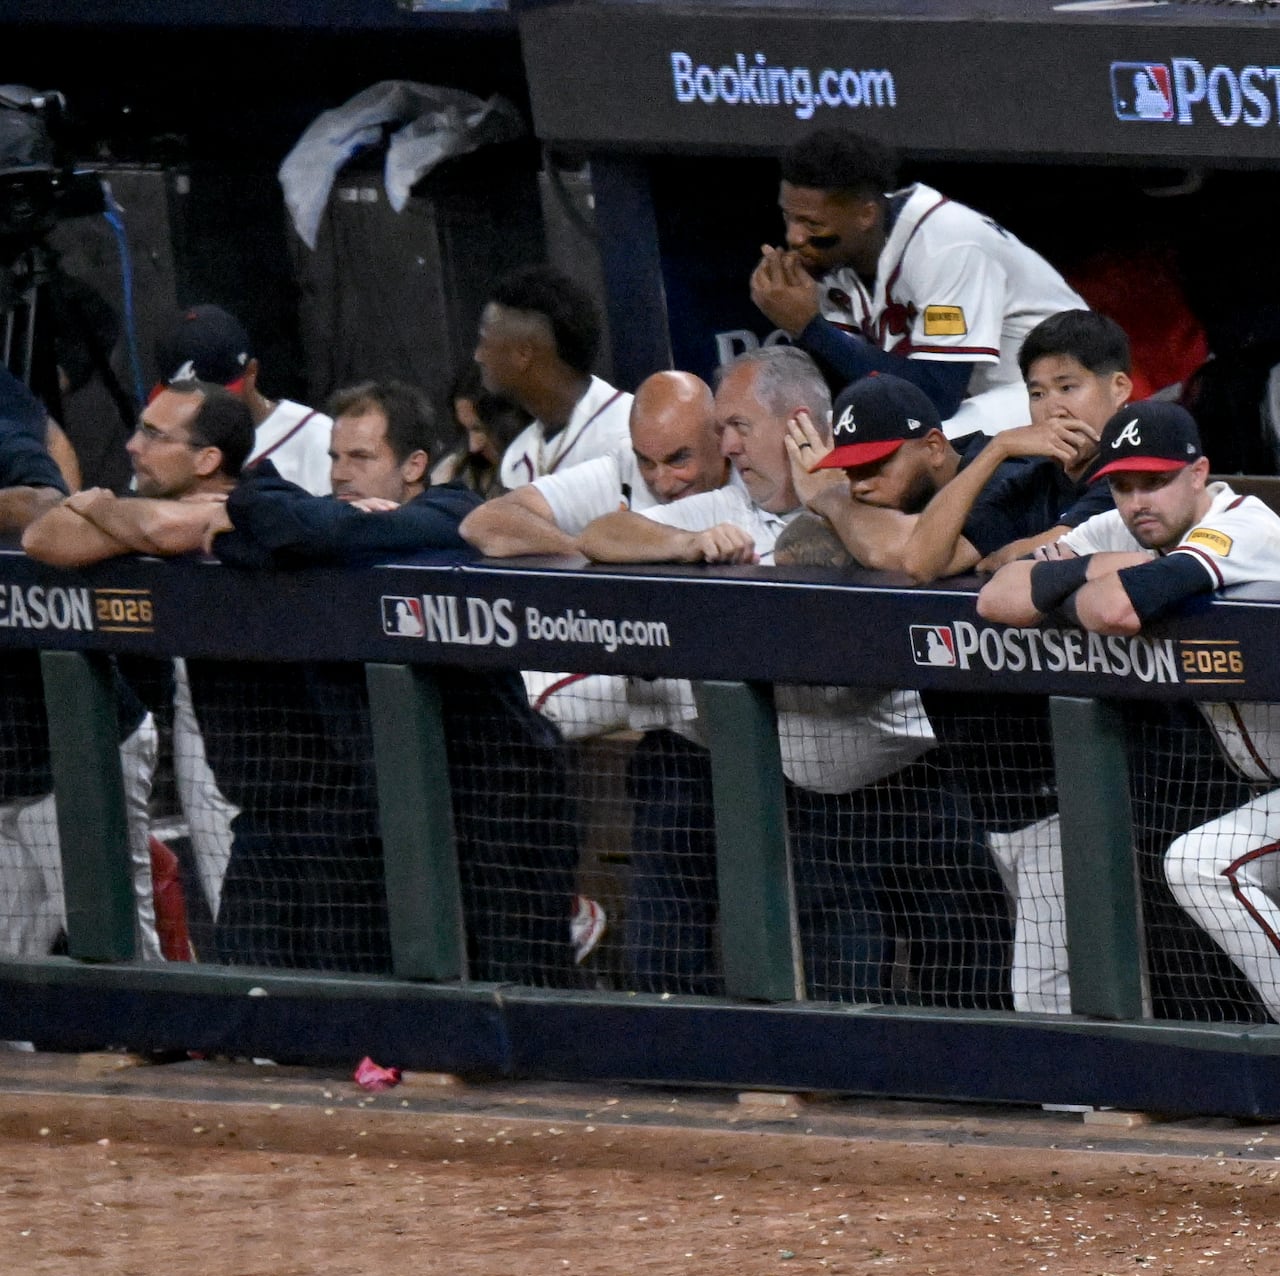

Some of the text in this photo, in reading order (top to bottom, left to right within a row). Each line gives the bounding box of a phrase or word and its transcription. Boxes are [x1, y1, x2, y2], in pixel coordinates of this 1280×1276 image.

[671, 52, 897, 119] Booking.com
[96, 599, 153, 623] 2026
[423, 594, 670, 652] NLDS Booking.com
[952, 621, 1244, 684] POSTSEASON 2026
